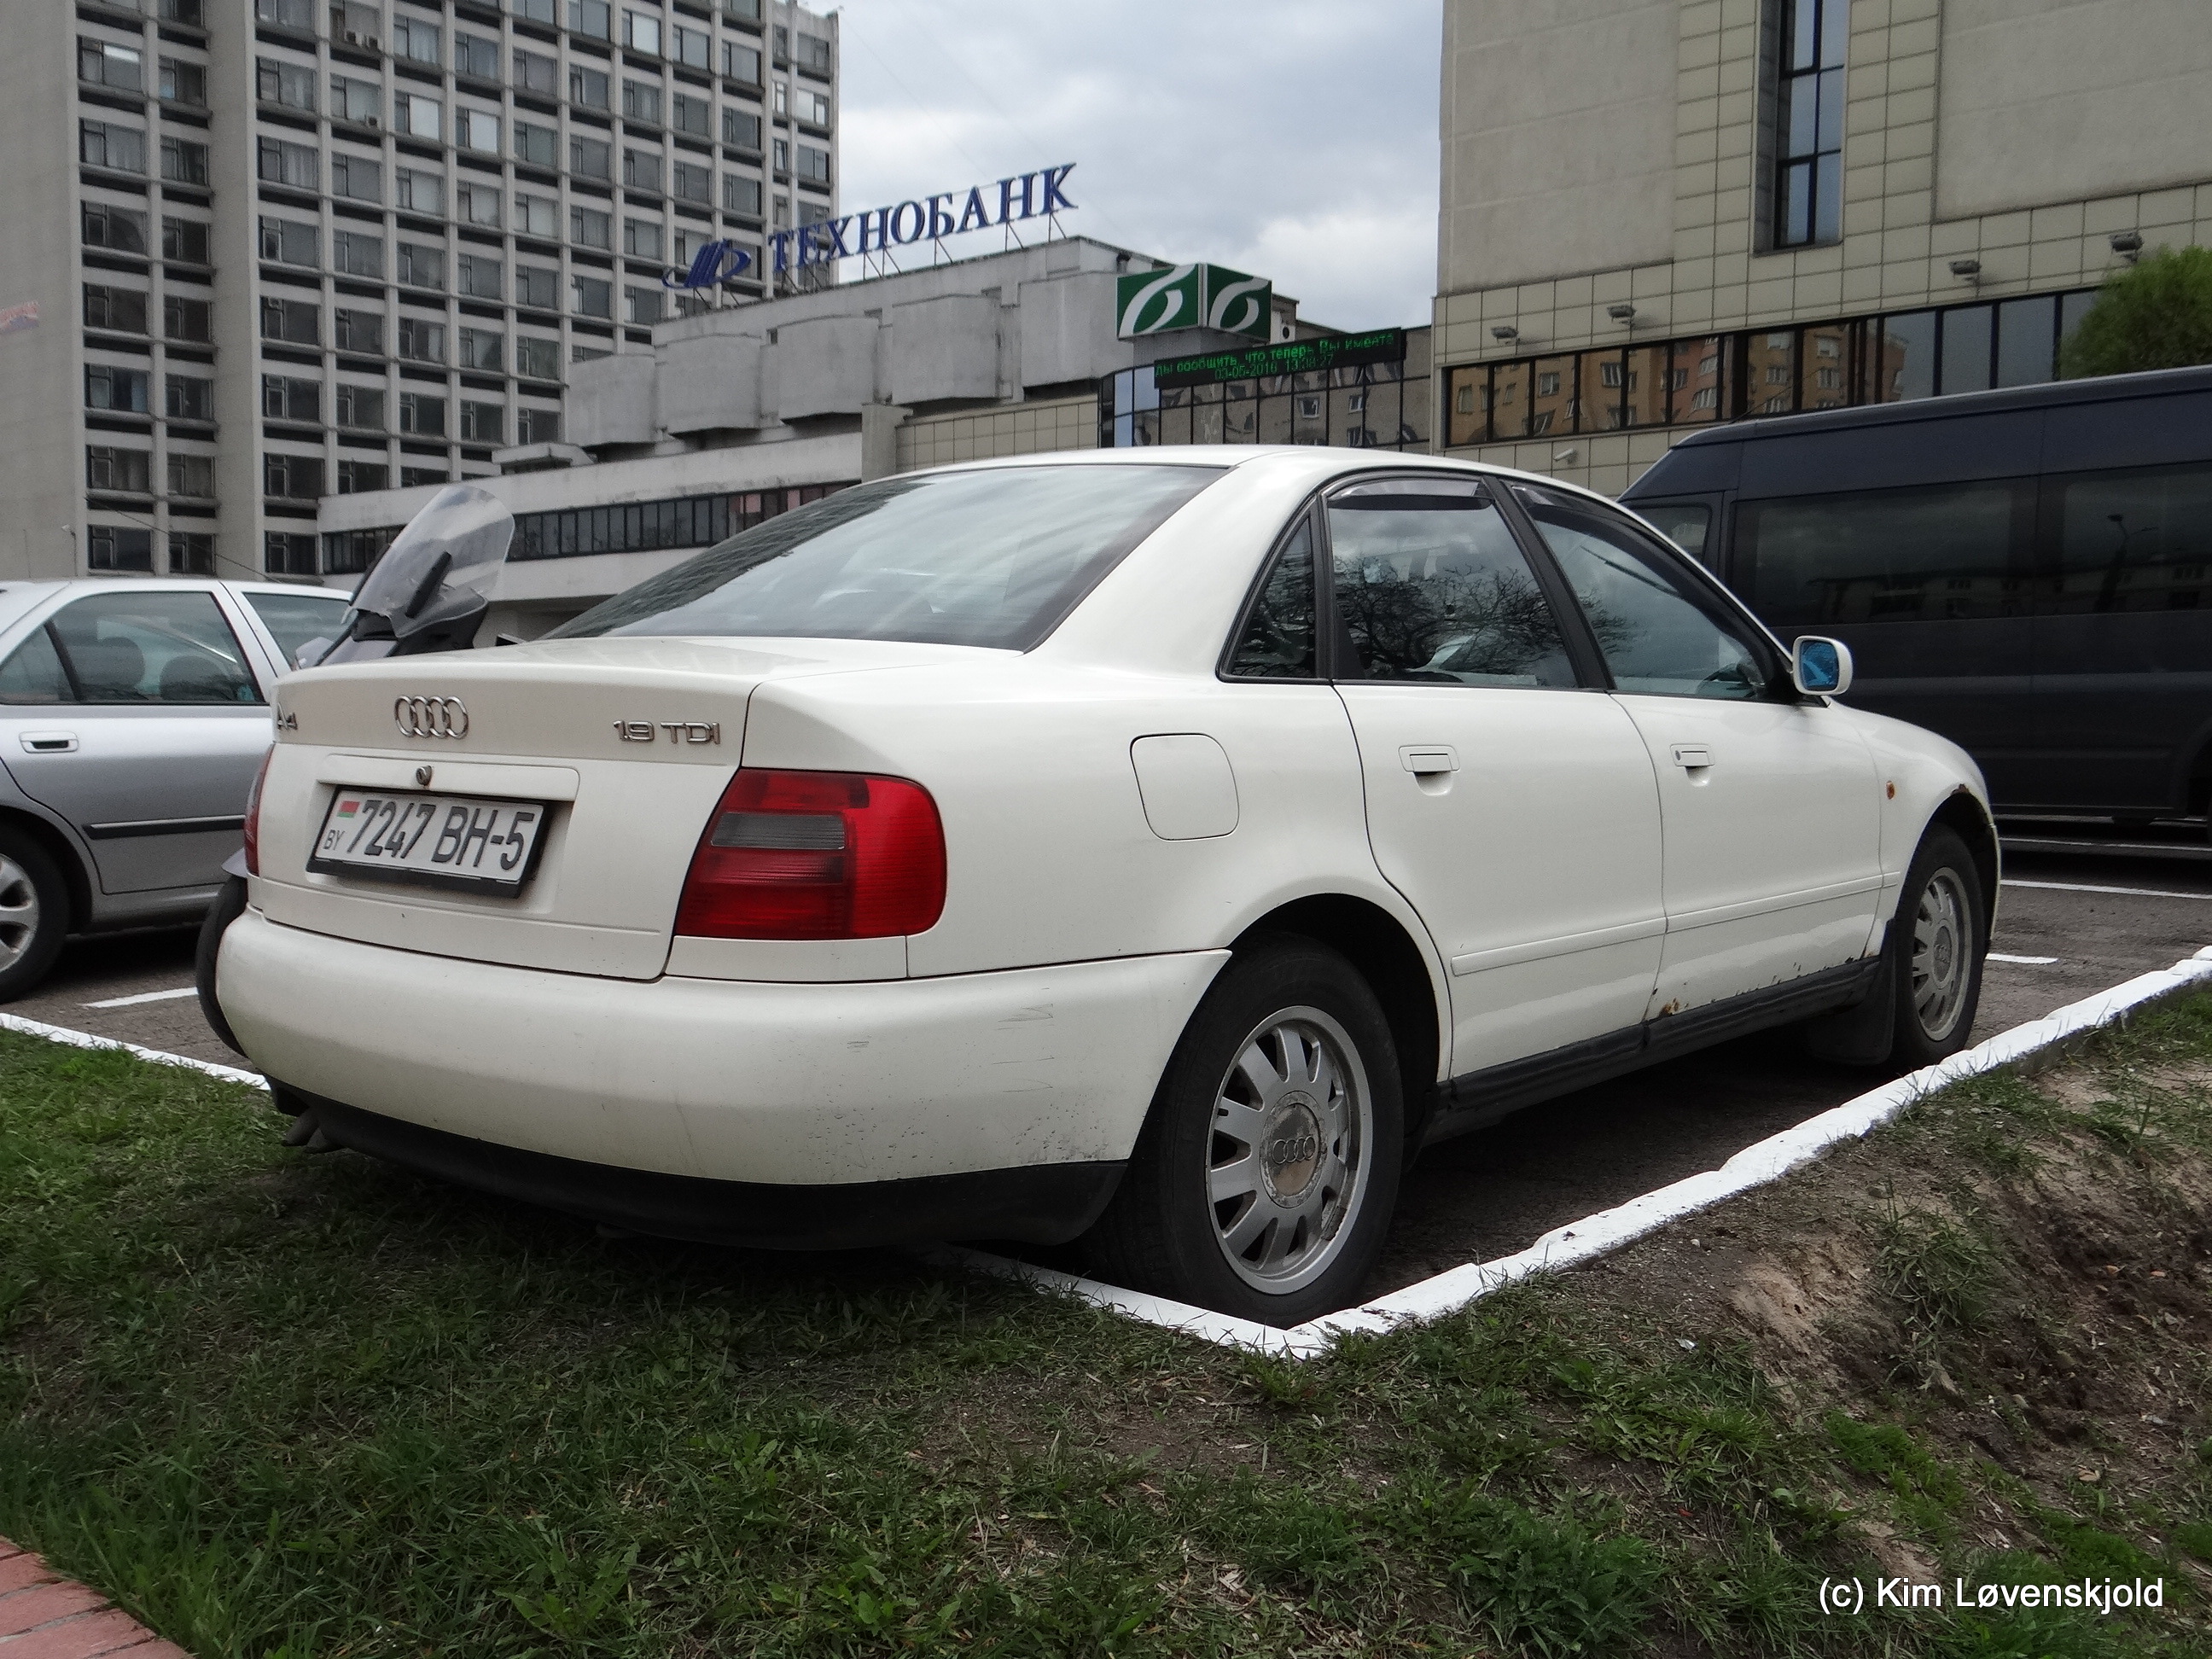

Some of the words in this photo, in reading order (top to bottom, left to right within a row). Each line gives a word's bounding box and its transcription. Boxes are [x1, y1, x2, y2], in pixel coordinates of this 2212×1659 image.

[768, 162, 1080, 273] ТЕХНОБАНК
[660, 720, 721, 744] TDI
[323, 829, 346, 851] BY
[347, 799, 436, 860] 7247
[431, 806, 535, 870] BH-5
